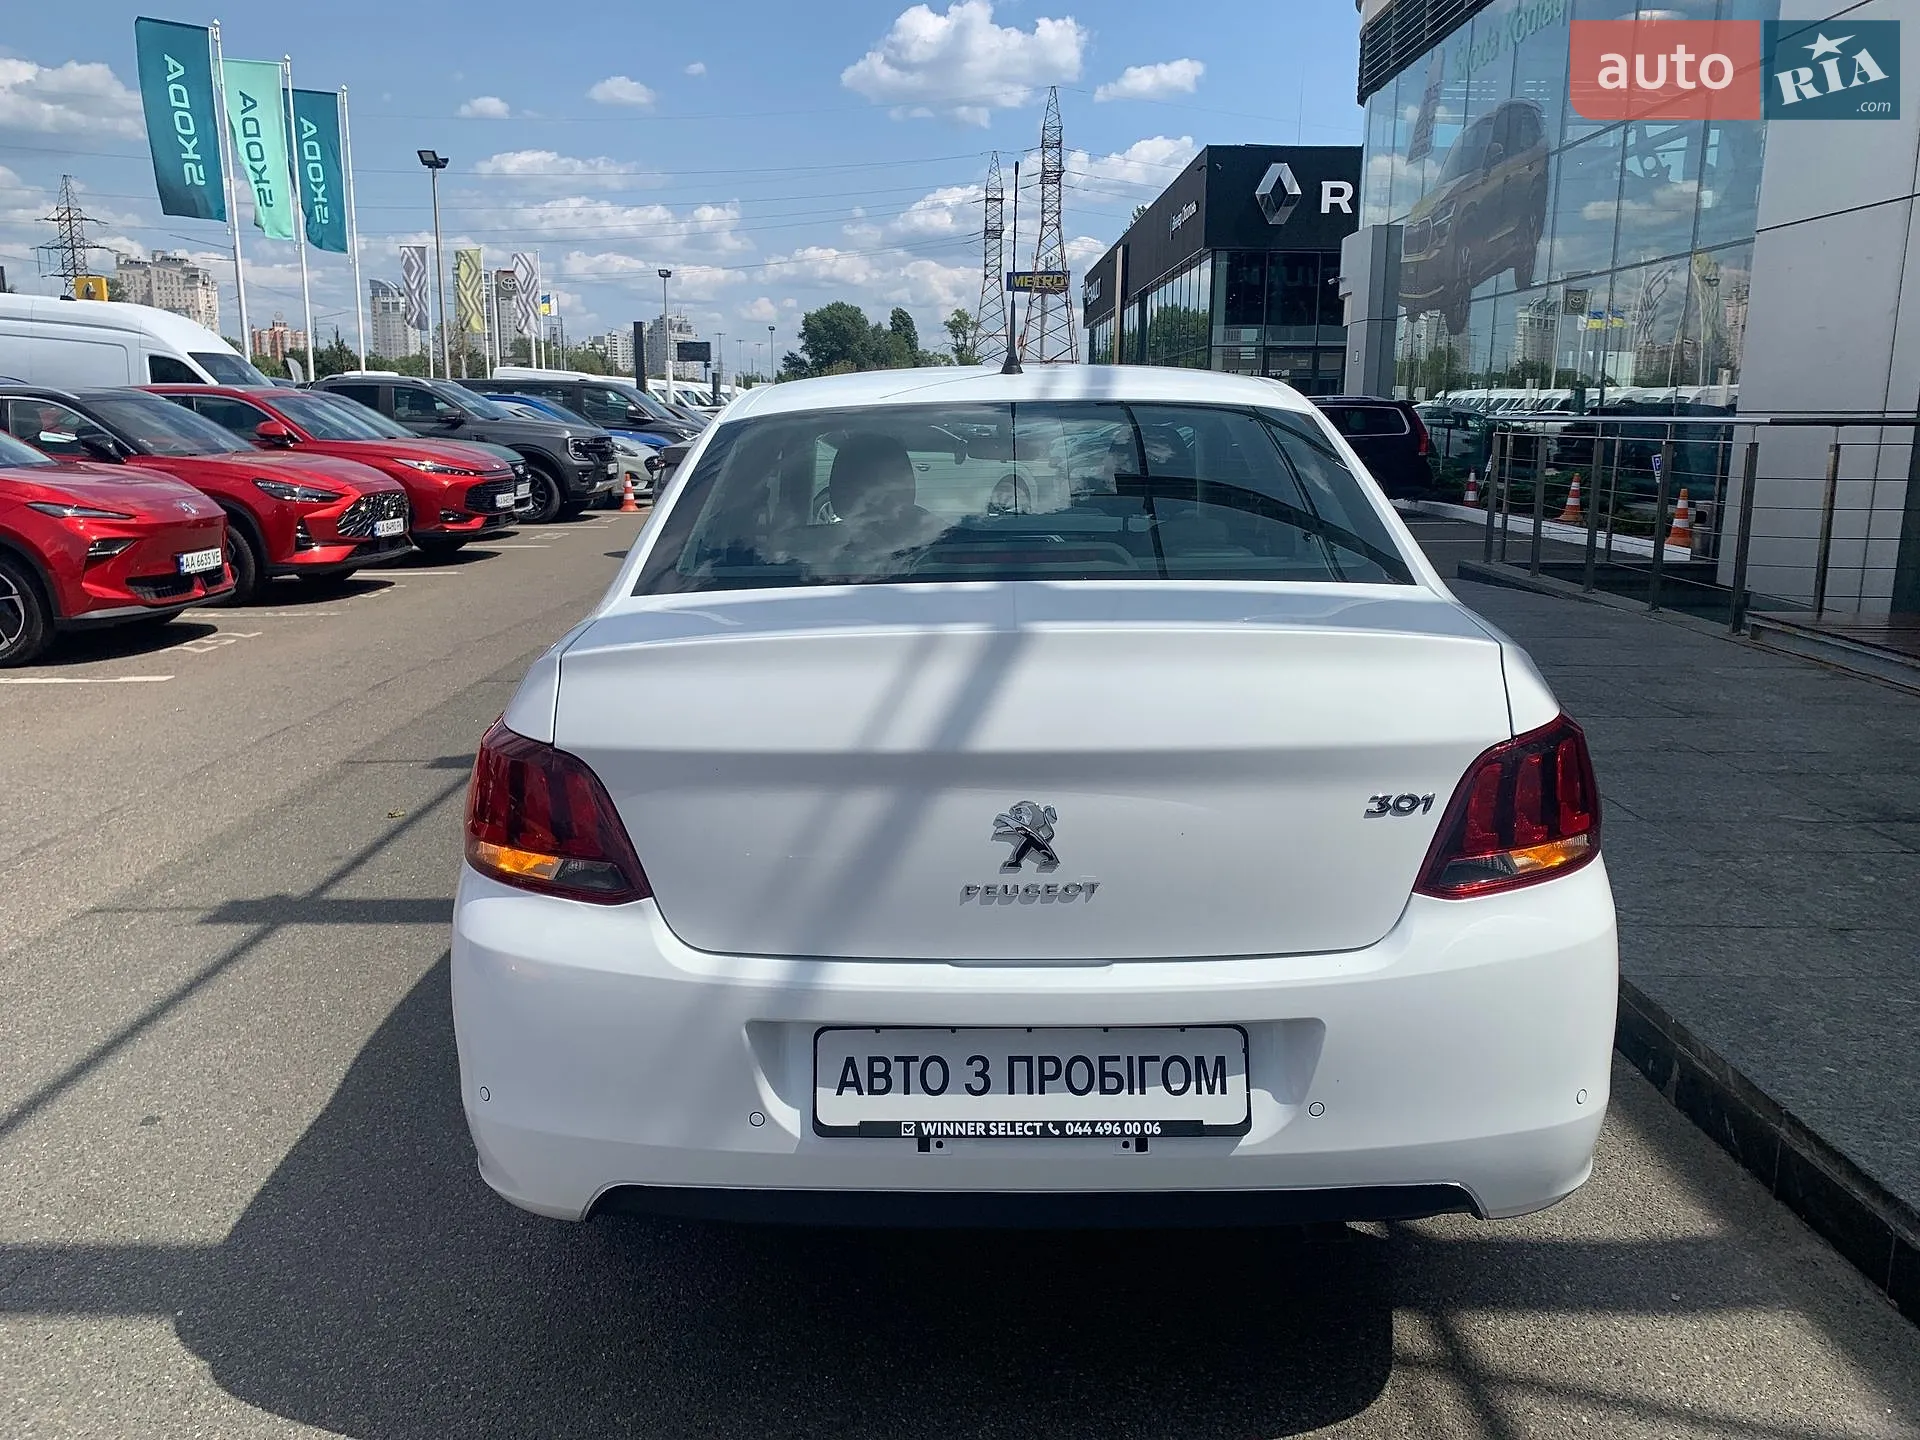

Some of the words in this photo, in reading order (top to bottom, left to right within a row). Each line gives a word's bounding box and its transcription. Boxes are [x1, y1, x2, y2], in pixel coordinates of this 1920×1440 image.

[1011, 275, 1068, 287] METRO
[185, 556, 196, 569] AA
[1364, 792, 1435, 818] 301
[962, 882, 1100, 902] PEUGEOT
[835, 1055, 950, 1097] АВТО
[964, 1055, 992, 1097] З
[1007, 1055, 1227, 1097] ПРОБІГОМ
[921, 1122, 986, 1136] WINNER
[989, 1122, 1043, 1136] SELECT
[1065, 1122, 1092, 1136] 044
[1094, 1122, 1121, 1136] 496
[1123, 1122, 1141, 1136] 00
[1143, 1122, 1161, 1136] 06
